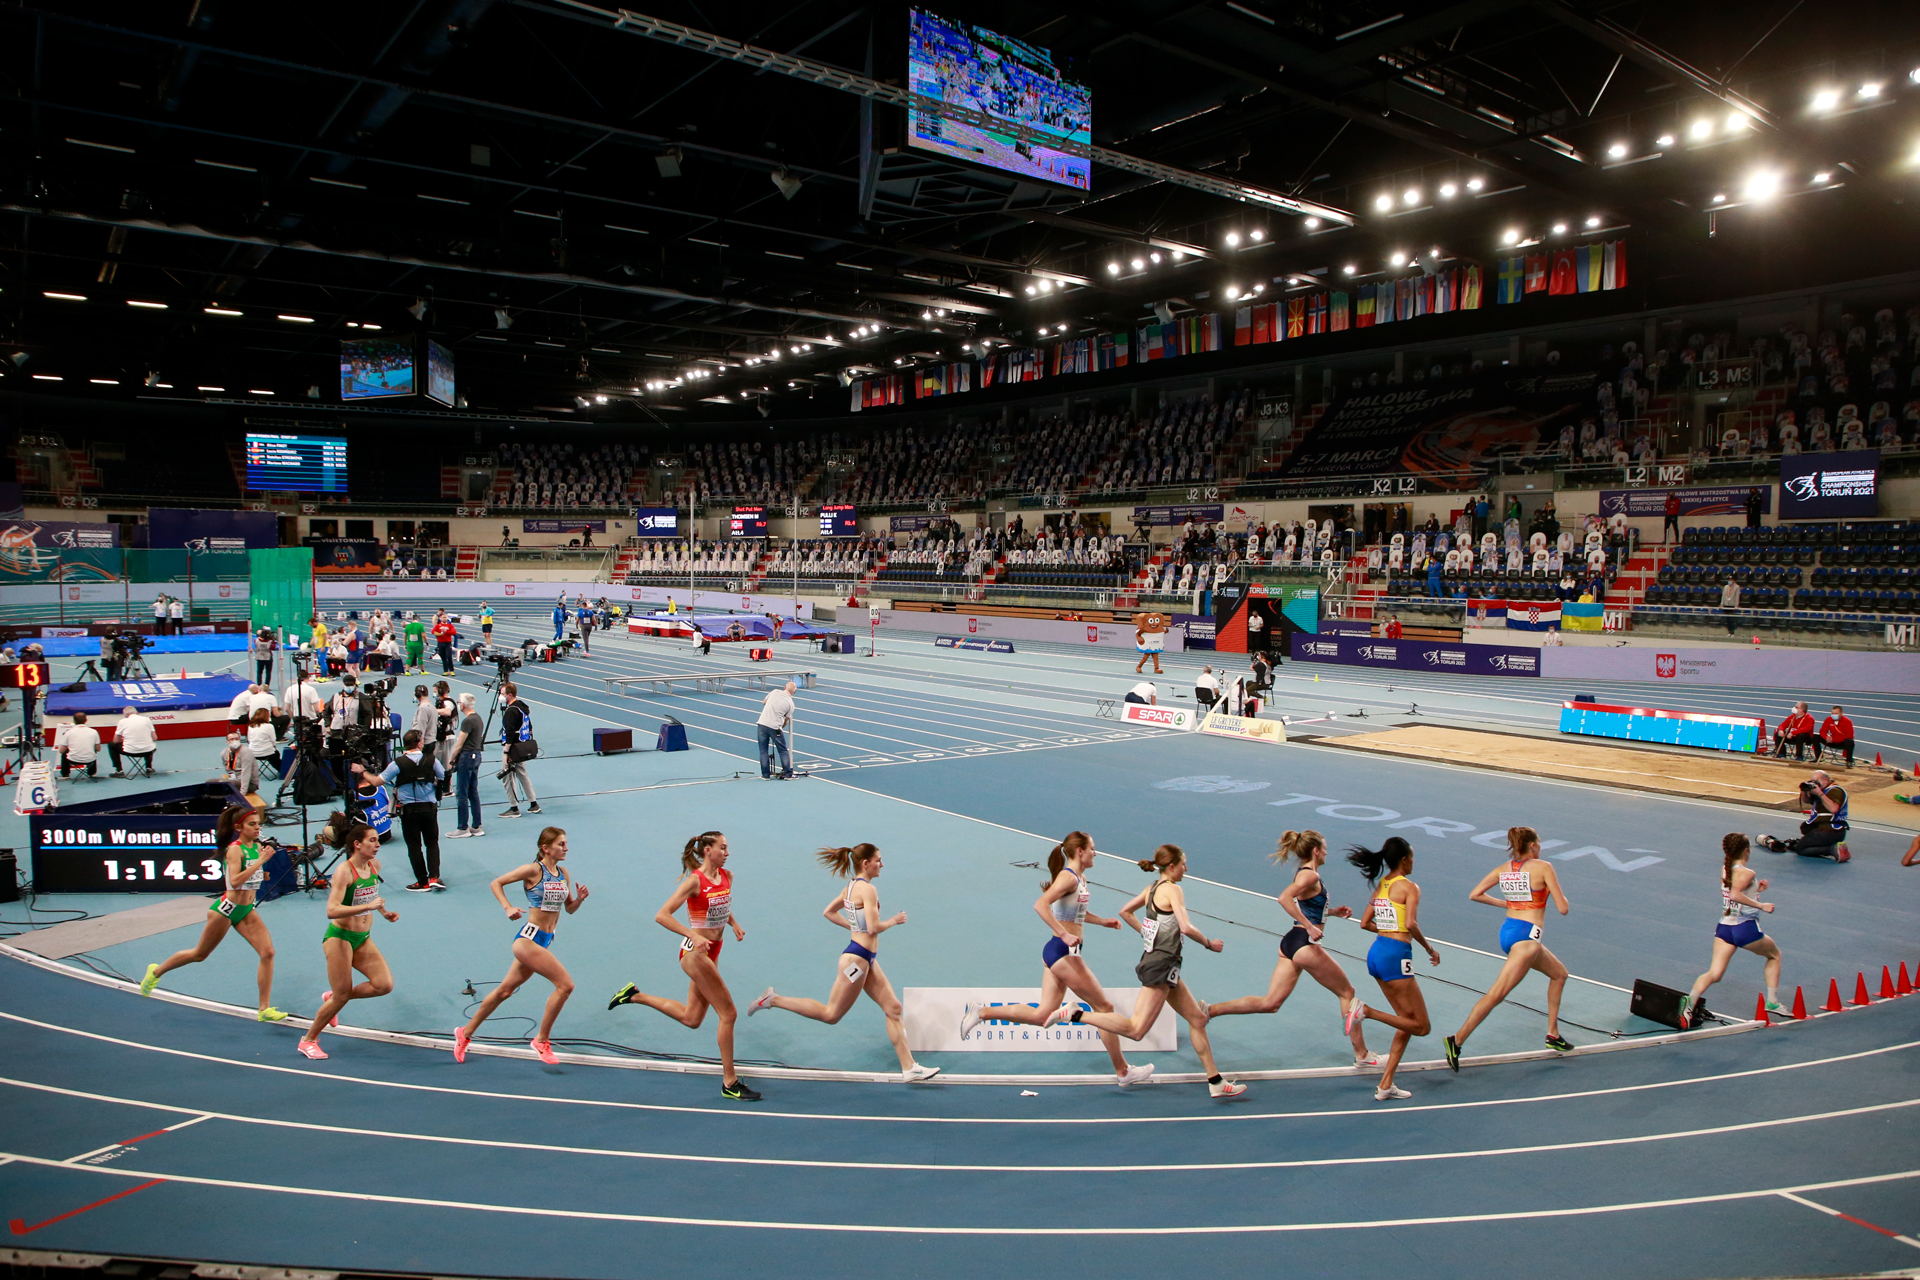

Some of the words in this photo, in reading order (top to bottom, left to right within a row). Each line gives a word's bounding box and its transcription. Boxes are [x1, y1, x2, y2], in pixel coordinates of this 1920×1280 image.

[1698, 369, 1719, 385] L3
[1726, 367, 1751, 383] M3
[1333, 388, 1474, 420] MISTRZOSTWA
[1344, 389, 1428, 408] HALOWE
[1275, 402, 1289, 414] K3
[1324, 416, 1403, 432] EUROPY
[1328, 446, 1400, 463] MARCA
[1626, 467, 1646, 483] L2
[1659, 465, 1684, 481] M2
[1373, 479, 1390, 493] K2
[1399, 478, 1415, 492] L2
[1821, 481, 1874, 489] CHAMPIONSHIPS
[1187, 488, 1198, 499] J2
[1204, 487, 1218, 499] K2
[1853, 487, 1874, 496] 2021
[62, 496, 76, 506] C2
[82, 497, 98, 507] D2
[303, 504, 316, 513] E2
[457, 507, 468, 515] E2
[475, 507, 486, 515] F2
[1269, 586, 1283, 594] 2021
[1328, 601, 1342, 616] L1
[1885, 624, 1916, 645] M1
[1680, 659, 1716, 667] Ministerstwo
[15, 663, 40, 687] 13
[1680, 668, 1700, 676] Sportu
[1138, 710, 1172, 723] SPAR
[31, 786, 46, 805] 6
[42, 829, 102, 844] 3000m
[110, 829, 171, 844] Women
[103, 859, 222, 881] 1:14.3
[1500, 881, 1529, 891] KOSTER
[221, 901, 233, 915] 12
[524, 925, 535, 937] 11
[1534, 928, 1541, 939] 3
[849, 967, 859, 977] 1
[1405, 961, 1411, 973] 5
[1170, 969, 1177, 980] 6
[965, 1030, 1015, 1040] SPORT
[1022, 1030, 1030, 1040] &
[1036, 1030, 1101, 1040] FLOORIN
